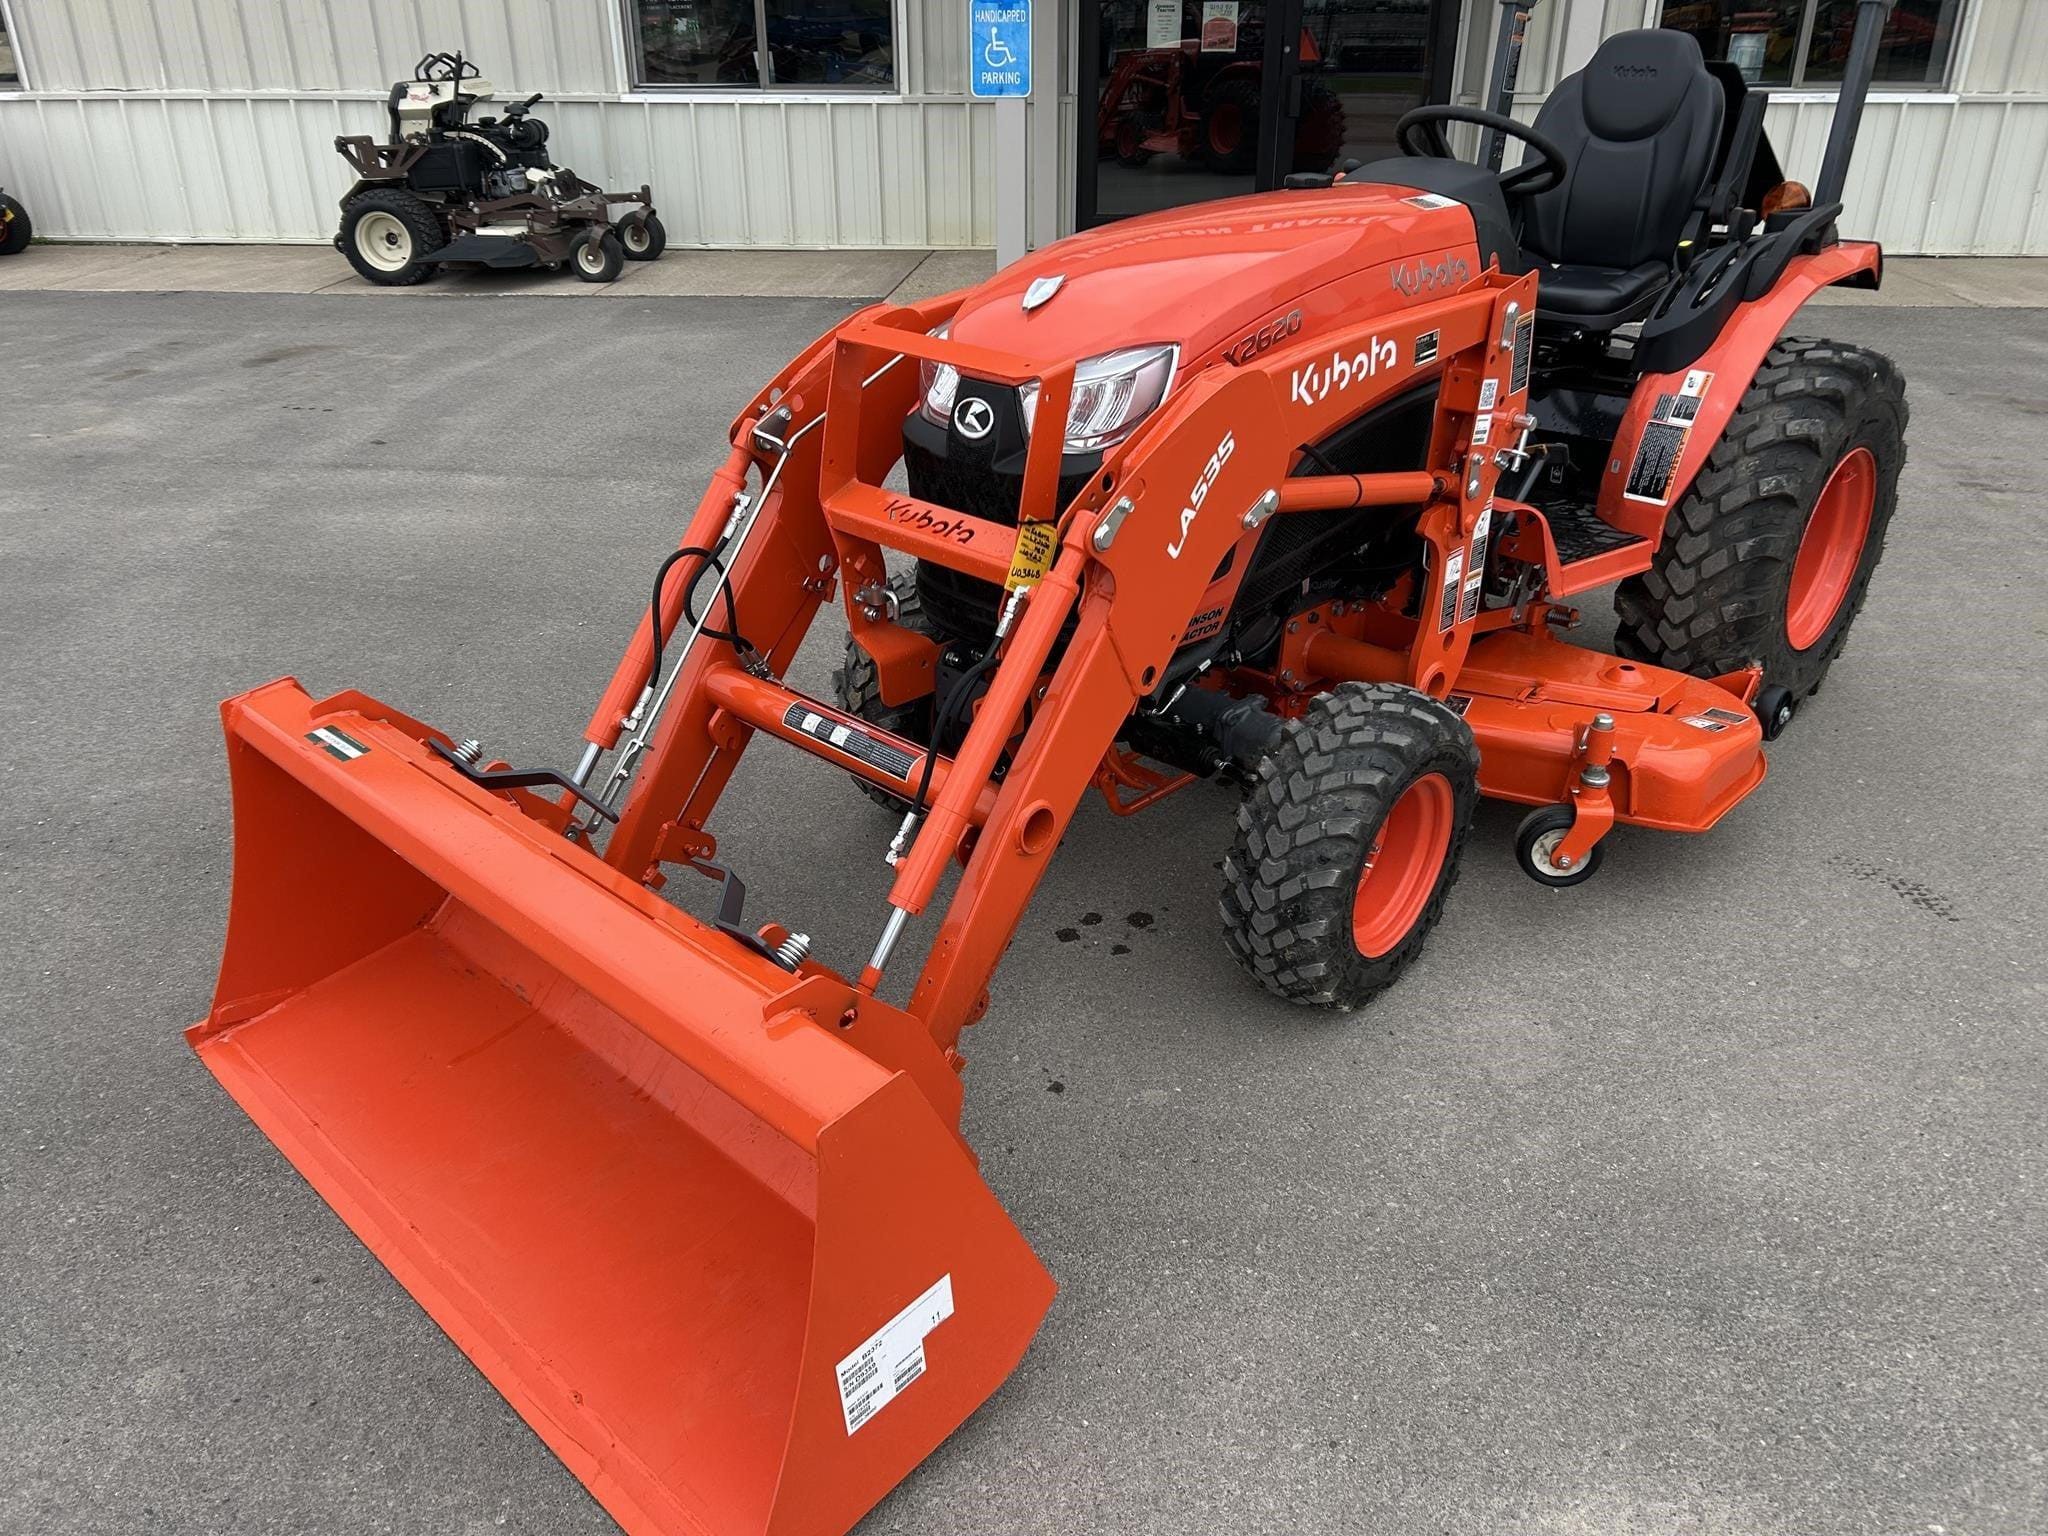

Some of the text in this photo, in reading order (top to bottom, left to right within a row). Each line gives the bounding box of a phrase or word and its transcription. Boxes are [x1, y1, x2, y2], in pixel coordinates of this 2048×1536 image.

[975, 9, 1026, 23] HANDICAPPED
[981, 71, 1021, 85] PARKING
[1391, 251, 1470, 296] Kubota
[1292, 335, 1397, 406] Kubota
[1166, 429, 1236, 560] LA535
[884, 500, 975, 544] Kubota
